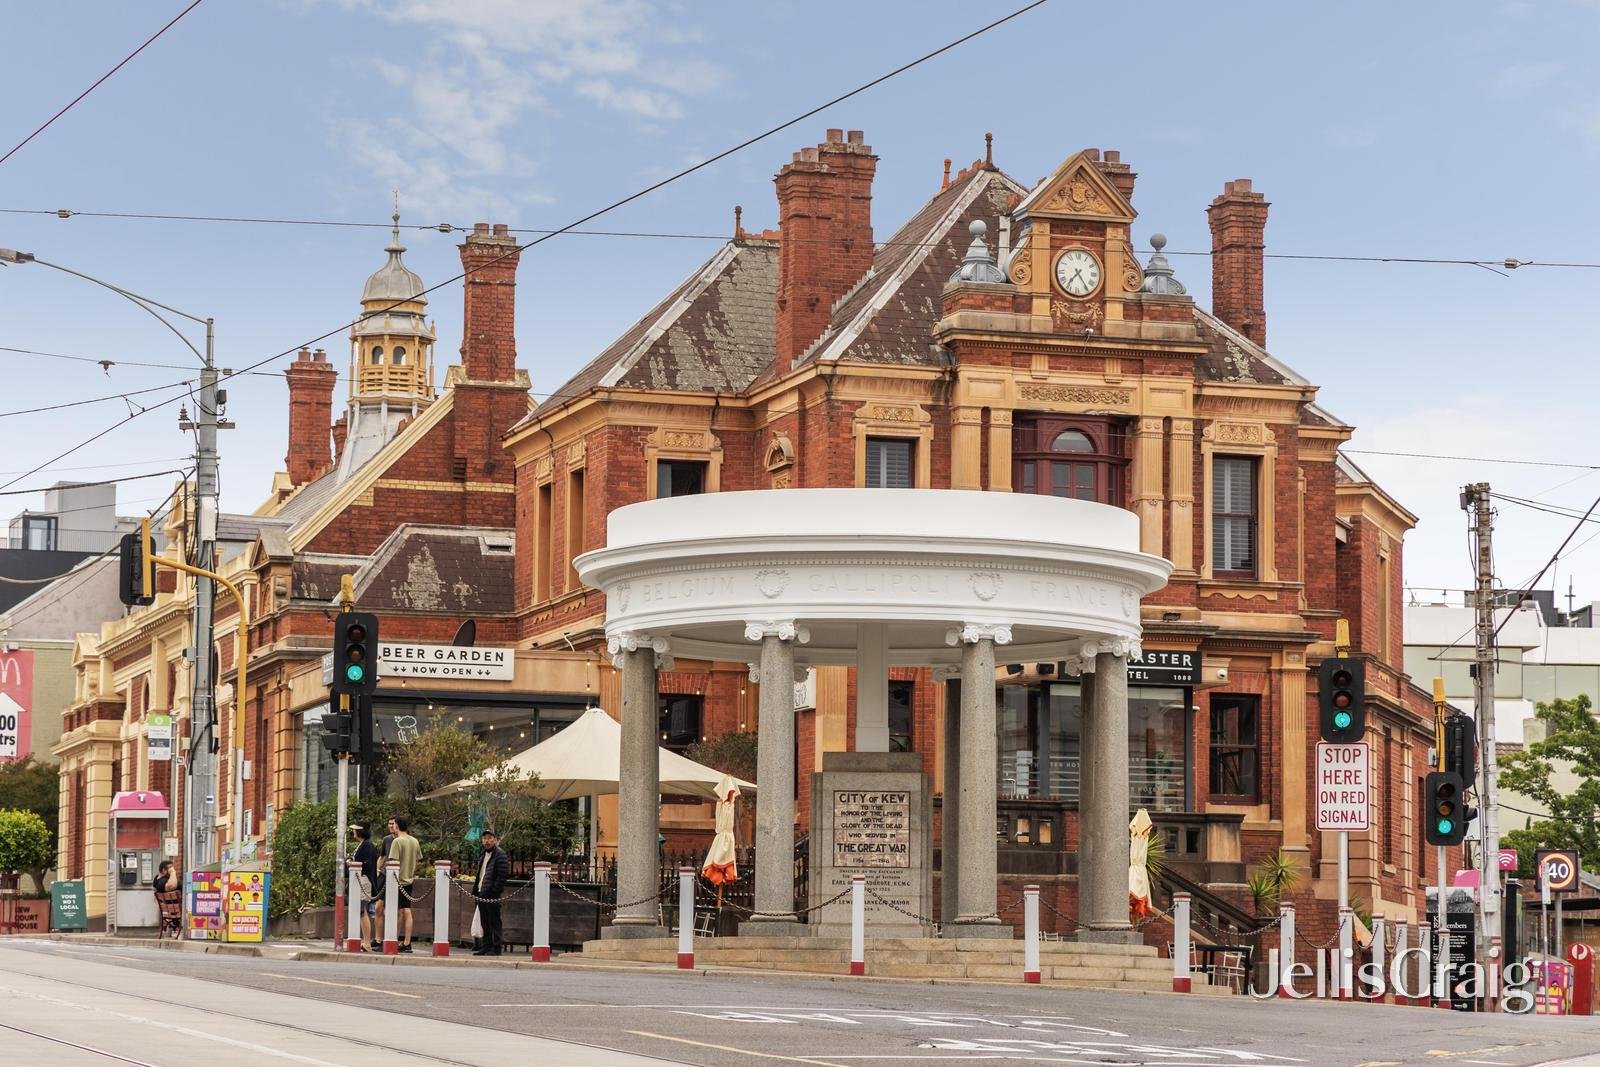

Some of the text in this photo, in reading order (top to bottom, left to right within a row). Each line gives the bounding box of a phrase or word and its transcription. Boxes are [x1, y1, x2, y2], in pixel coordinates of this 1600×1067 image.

[642, 576, 735, 602] BELGIUM
[808, 573, 951, 593] GALLIPOLI
[1030, 581, 1109, 606] FRANCE
[383, 647, 504, 662] BEER GARDEN
[1128, 652, 1192, 667] ASTER
[412, 666, 472, 676] NOW OPEN
[1128, 671, 1149, 680] TEL
[0, 715, 15, 731] 00
[0, 734, 15, 746] trs
[1324, 748, 1361, 763] STOP
[1323, 770, 1362, 785] HERE
[839, 793, 867, 803] CITY
[881, 793, 905, 803] KEW
[1320, 791, 1365, 804] ON RED
[1320, 810, 1366, 823] SIGNAL
[837, 843, 906, 853] THE GREAT WAR
[1549, 863, 1569, 879] 40
